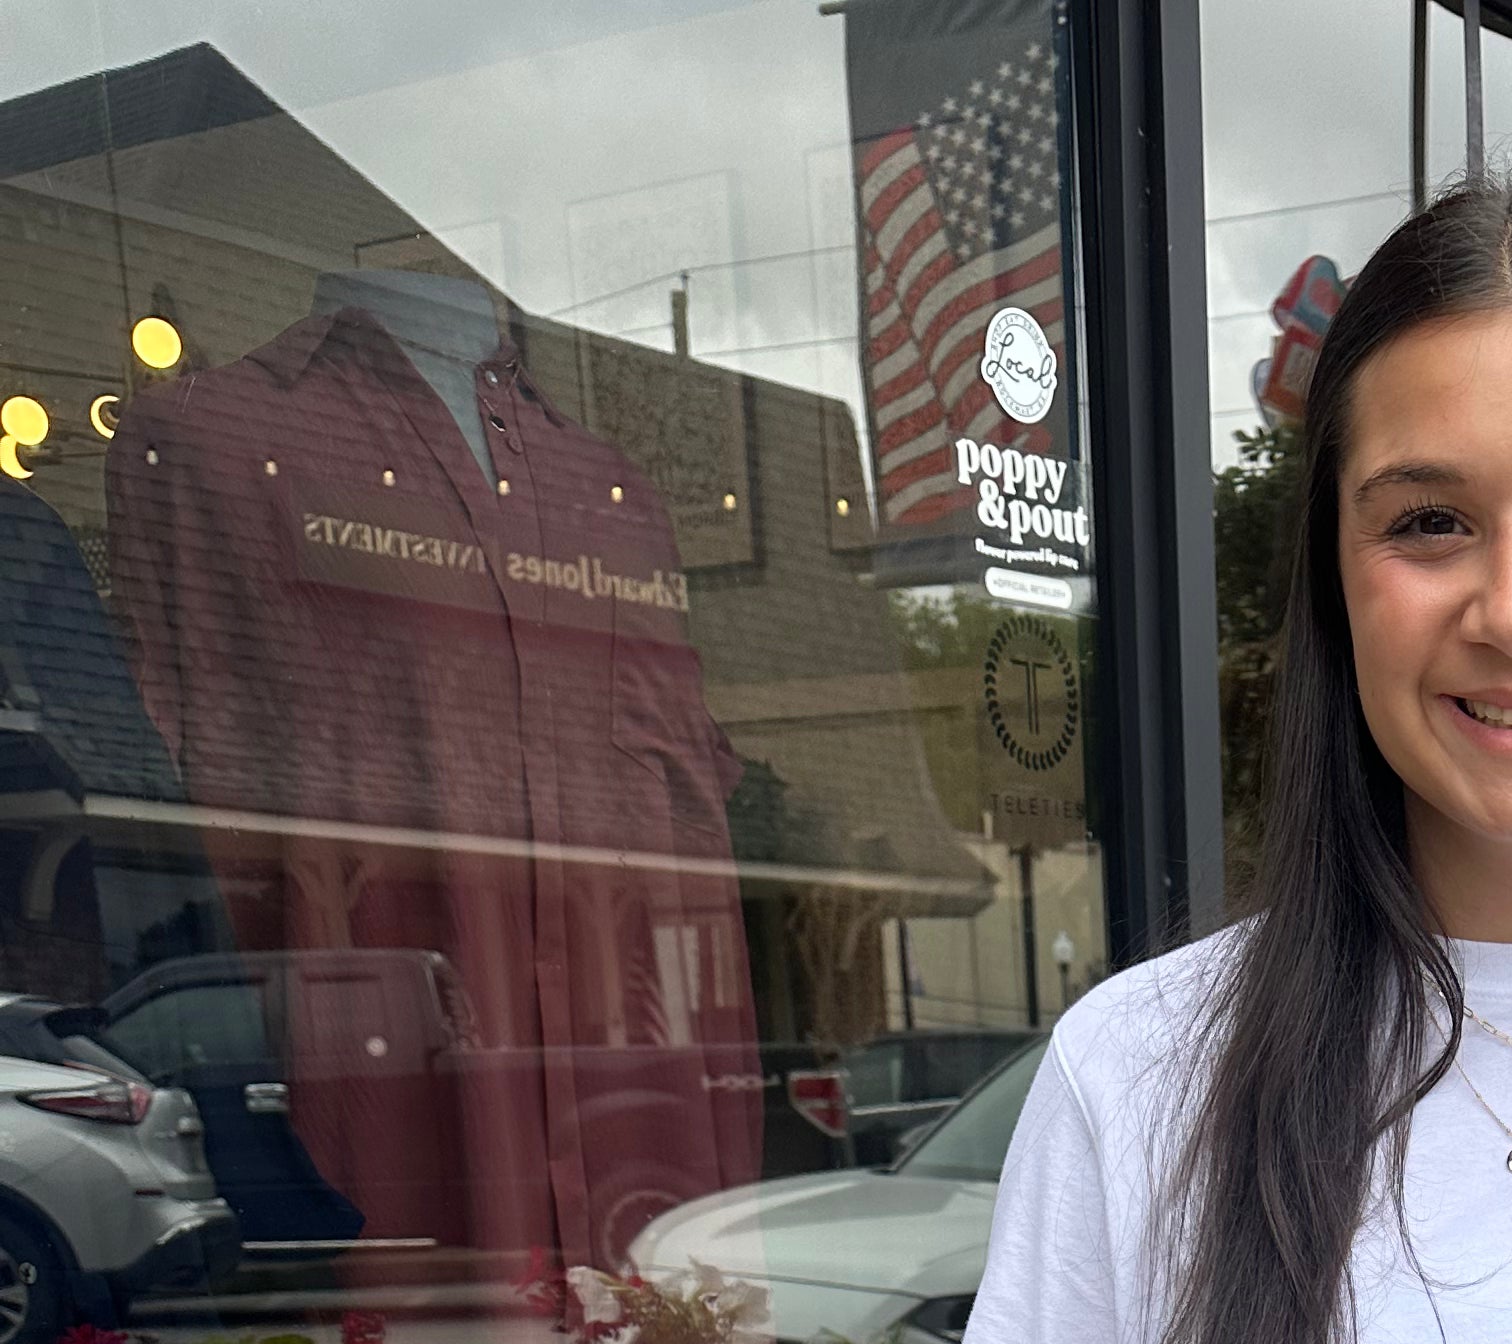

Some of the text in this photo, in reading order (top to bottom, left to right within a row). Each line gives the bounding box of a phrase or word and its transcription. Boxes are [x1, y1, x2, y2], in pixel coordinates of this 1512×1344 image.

[986, 332, 1053, 389] Local
[955, 438, 1067, 504] poppy
[977, 479, 1090, 547] &pout
